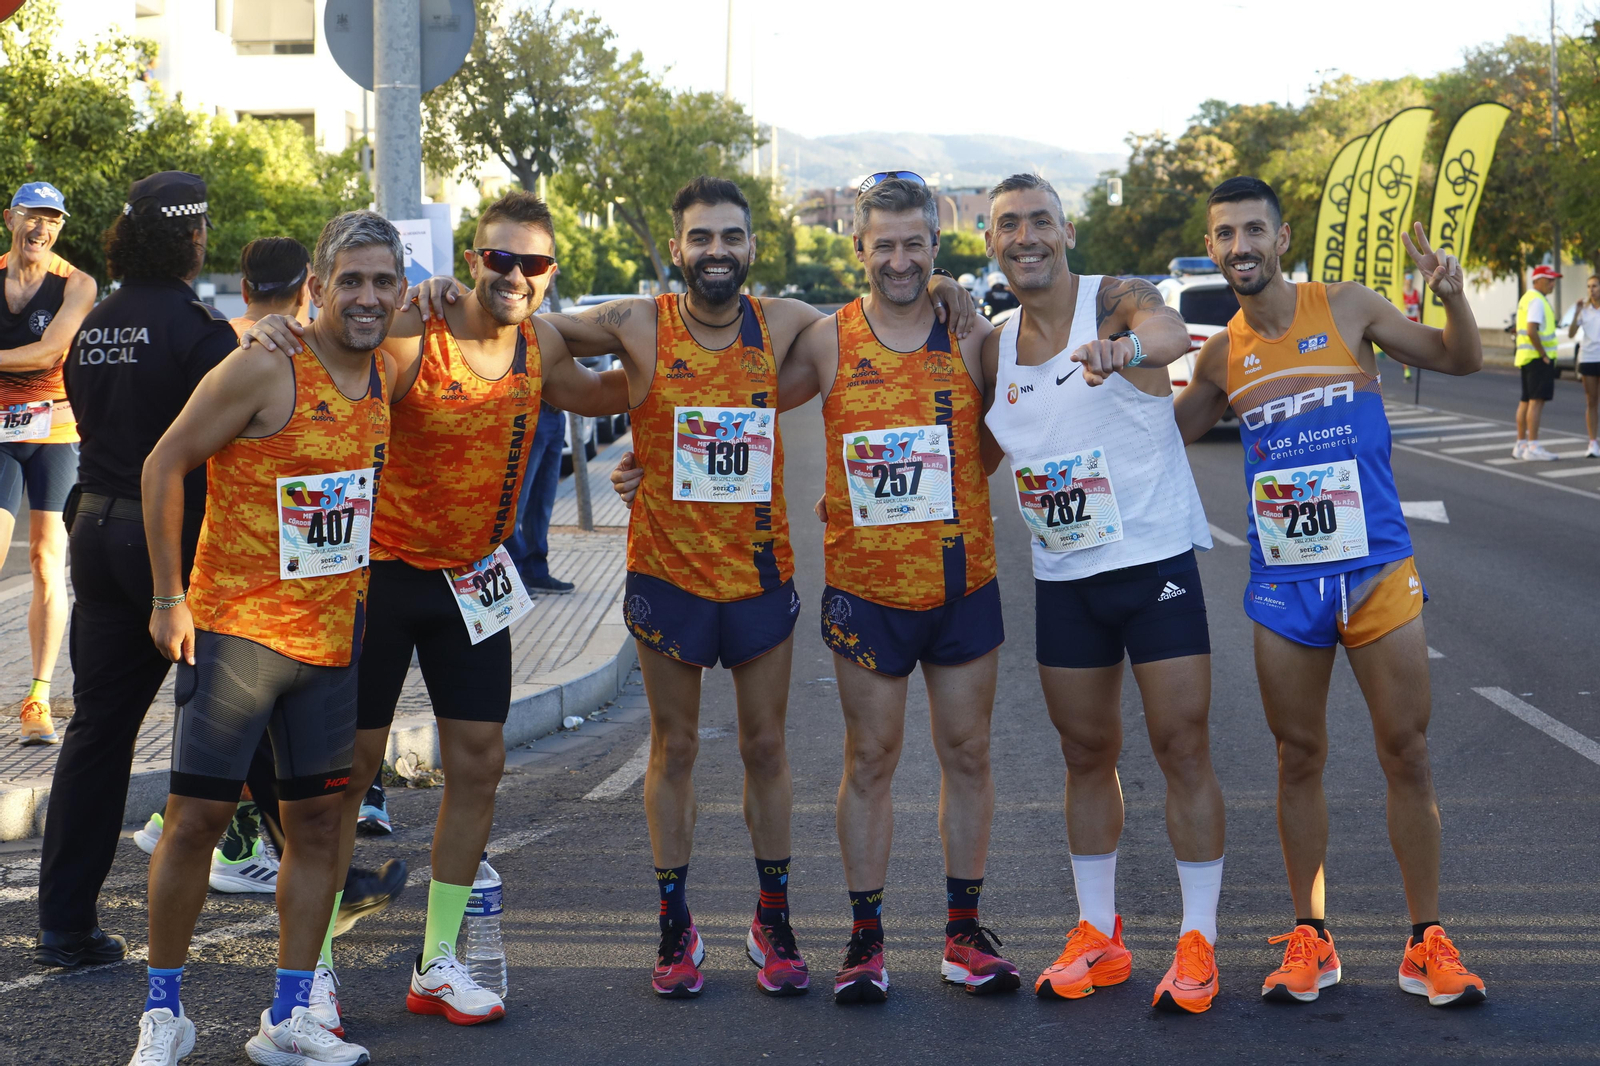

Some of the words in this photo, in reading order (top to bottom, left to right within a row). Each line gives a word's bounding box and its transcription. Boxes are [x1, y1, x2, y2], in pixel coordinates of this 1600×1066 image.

[77, 327, 150, 346] POLICIA
[79, 347, 138, 366] LOCAL
[1244, 365, 1262, 375] mobel
[1020, 384, 1034, 394] NN
[4, 412, 32, 428] 150
[1241, 381, 1354, 431] CAPA
[1267, 437, 1293, 451] Los
[1298, 424, 1353, 445] Alcores
[1271, 448, 1304, 461] Centro
[1308, 435, 1358, 453] Comercial
[705, 442, 749, 476] 130
[489, 413, 528, 545] MARCHENA
[872, 461, 924, 499] 257
[1040, 488, 1092, 528] 282
[1282, 500, 1338, 539] 230
[307, 507, 355, 548] 407
[473, 562, 513, 608] 323
[1157, 588, 1187, 602] adidas
